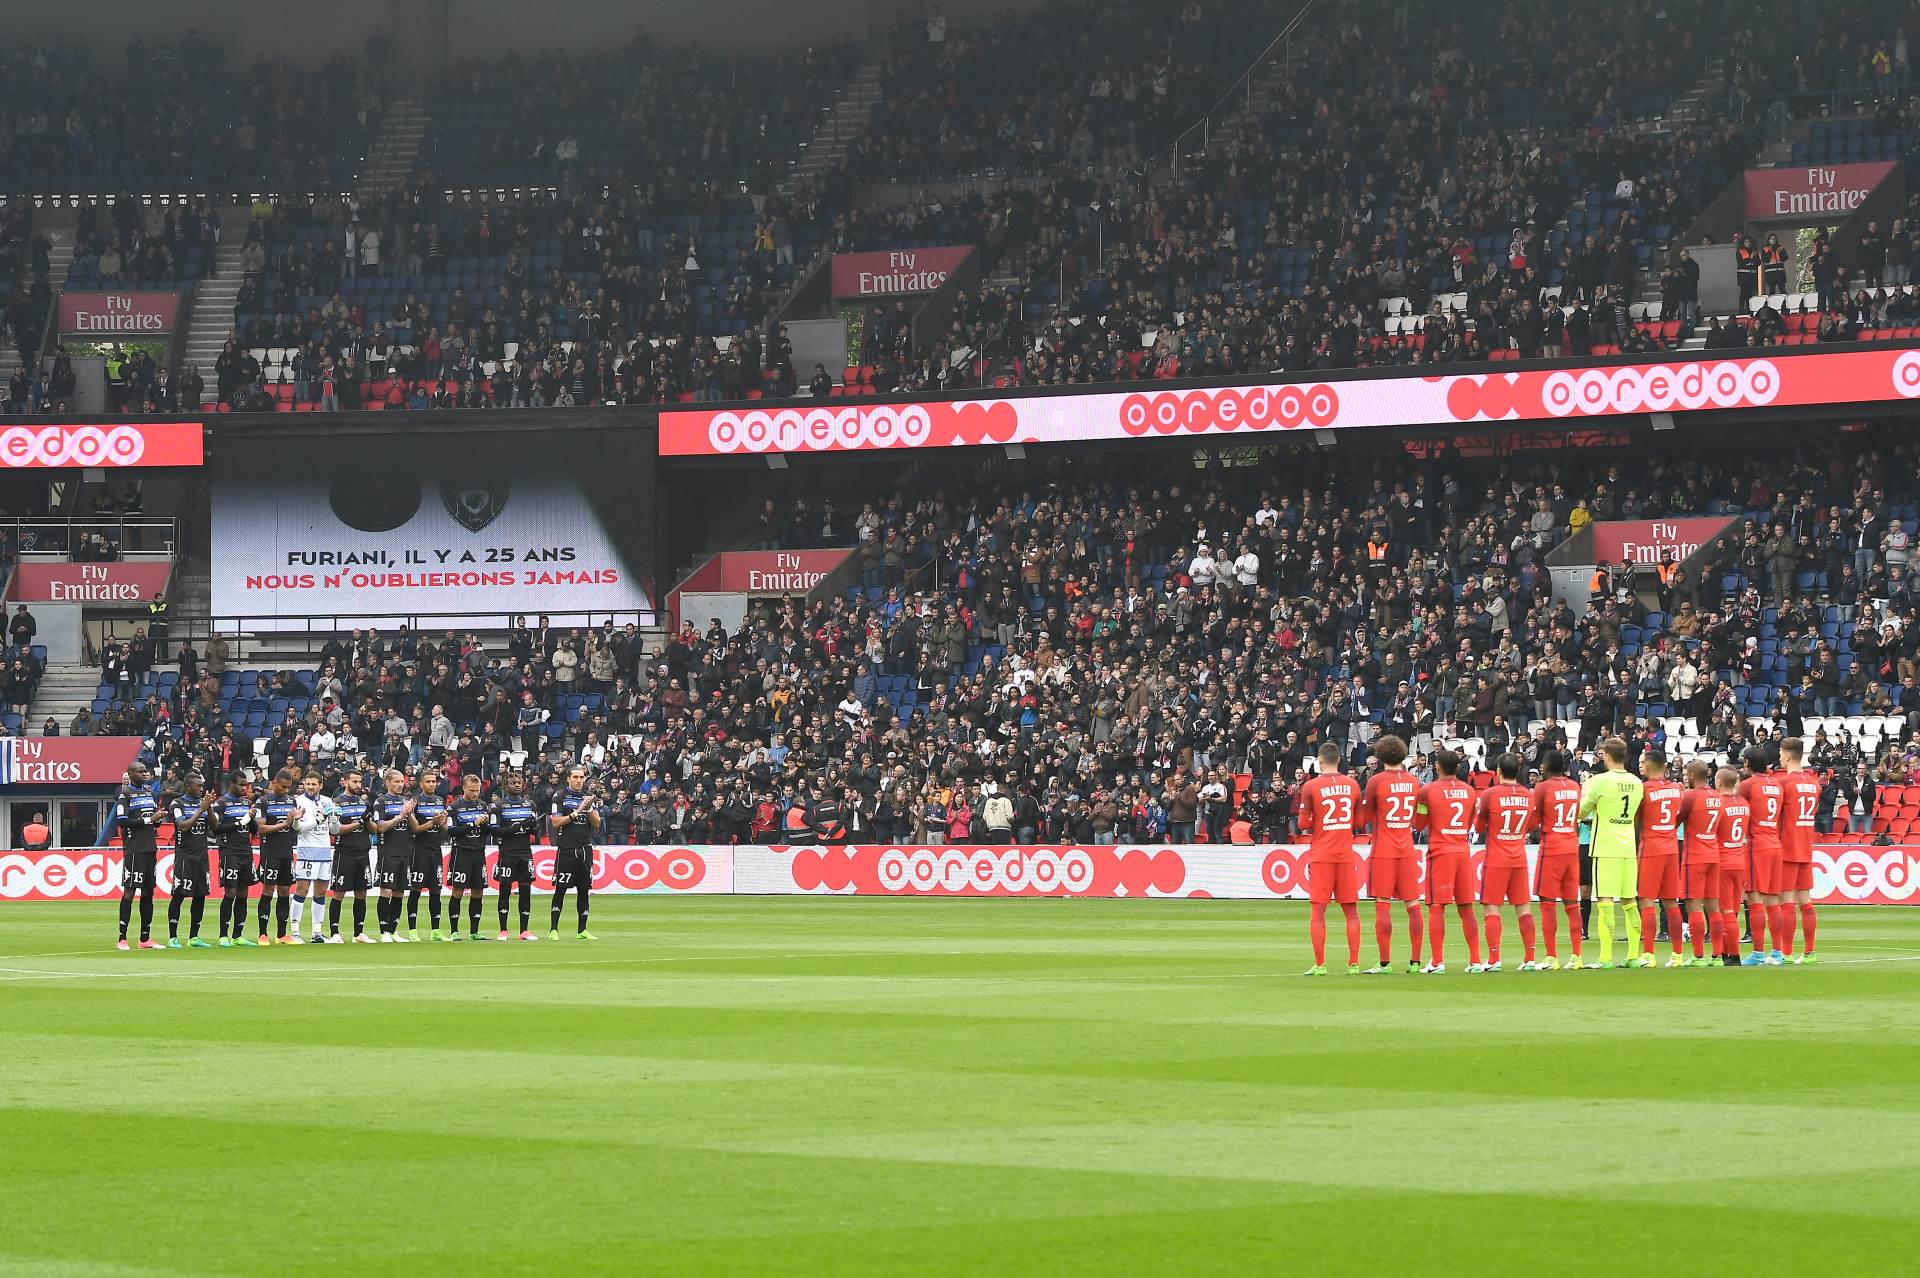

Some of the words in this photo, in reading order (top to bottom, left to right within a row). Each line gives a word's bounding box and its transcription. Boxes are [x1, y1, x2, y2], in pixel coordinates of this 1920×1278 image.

[1807, 167, 1836, 188] Fly
[889, 251, 916, 270] Fly
[858, 268, 948, 294] Emirates
[106, 295, 132, 312] Fly
[75, 310, 163, 330] Emirates
[1546, 361, 1775, 411] ooredoo
[1123, 387, 1334, 431] ooredoo
[713, 406, 927, 448] ooredoo
[1651, 522, 1677, 541] Fly
[287, 550, 396, 568] FURIANI,
[405, 550, 427, 564] IL
[433, 549, 451, 564] Y
[459, 550, 477, 563] A
[485, 547, 515, 563] 25
[523, 547, 576, 562] ANS
[777, 553, 801, 570] Fly
[81, 564, 108, 581] Fly
[246, 574, 315, 589] NOUS
[524, 569, 618, 585] JAMAIS
[50, 579, 140, 601] Emirates
[15, 756, 81, 781] irates
[1321, 797, 1352, 824] 23
[1385, 795, 1415, 821] 25
[1499, 796, 1529, 807] MAXWELL
[1621, 794, 1629, 818] 1
[1660, 800, 1672, 824] 5
[1767, 797, 1778, 820] 9
[1797, 795, 1816, 820] 12
[1449, 801, 1464, 827] 2
[1500, 809, 1528, 834] 17
[1553, 802, 1577, 827] 14
[1707, 810, 1719, 833] 7
[1731, 818, 1743, 841] 6
[226, 868, 239, 880] 25
[266, 868, 279, 880] 23
[302, 861, 313, 870] 16
[500, 866, 512, 878] 10
[880, 850, 1091, 888] ooredoo
[133, 871, 144, 883] 15
[182, 878, 193, 891] 12
[337, 874, 345, 886] 4
[383, 872, 395, 883] 14
[411, 871, 425, 882] 19
[453, 871, 467, 883] 20
[558, 872, 572, 883] 27
